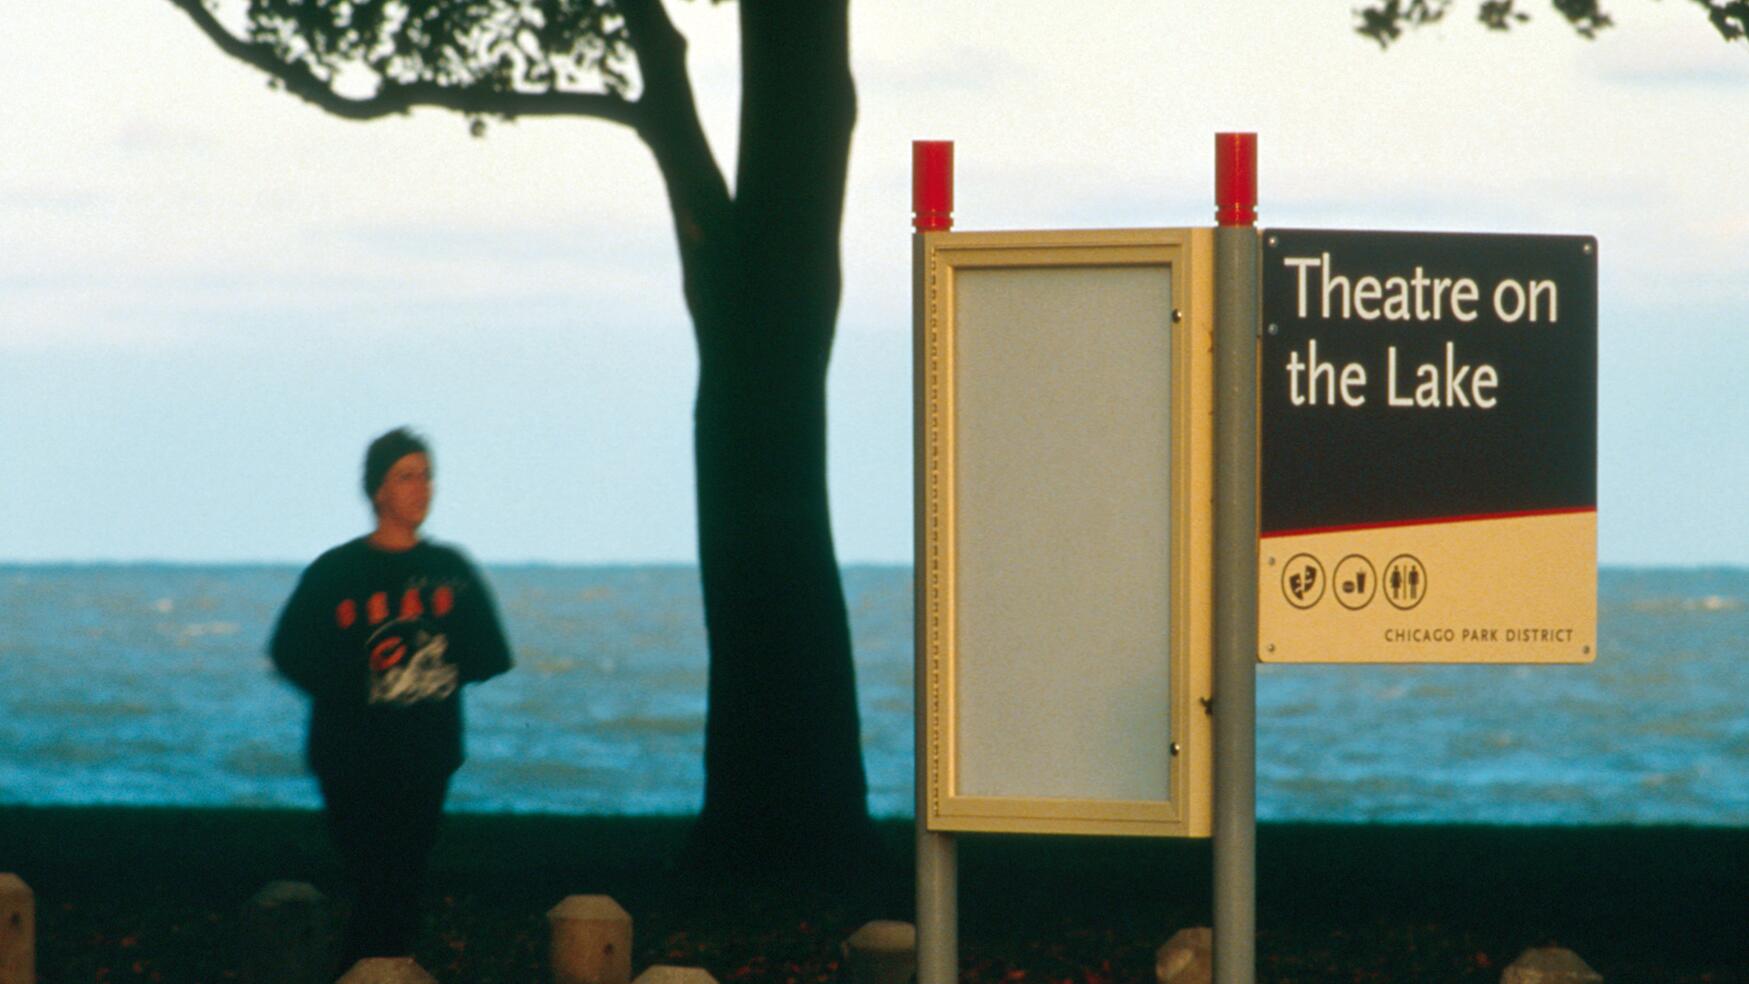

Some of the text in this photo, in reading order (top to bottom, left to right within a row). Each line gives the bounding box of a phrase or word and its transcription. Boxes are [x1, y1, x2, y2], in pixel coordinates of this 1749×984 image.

[1283, 252, 1557, 322] Theatre on
[1286, 338, 1498, 408] the Lake
[1384, 628, 1573, 643] CHICAGO PARK DISTRICT
